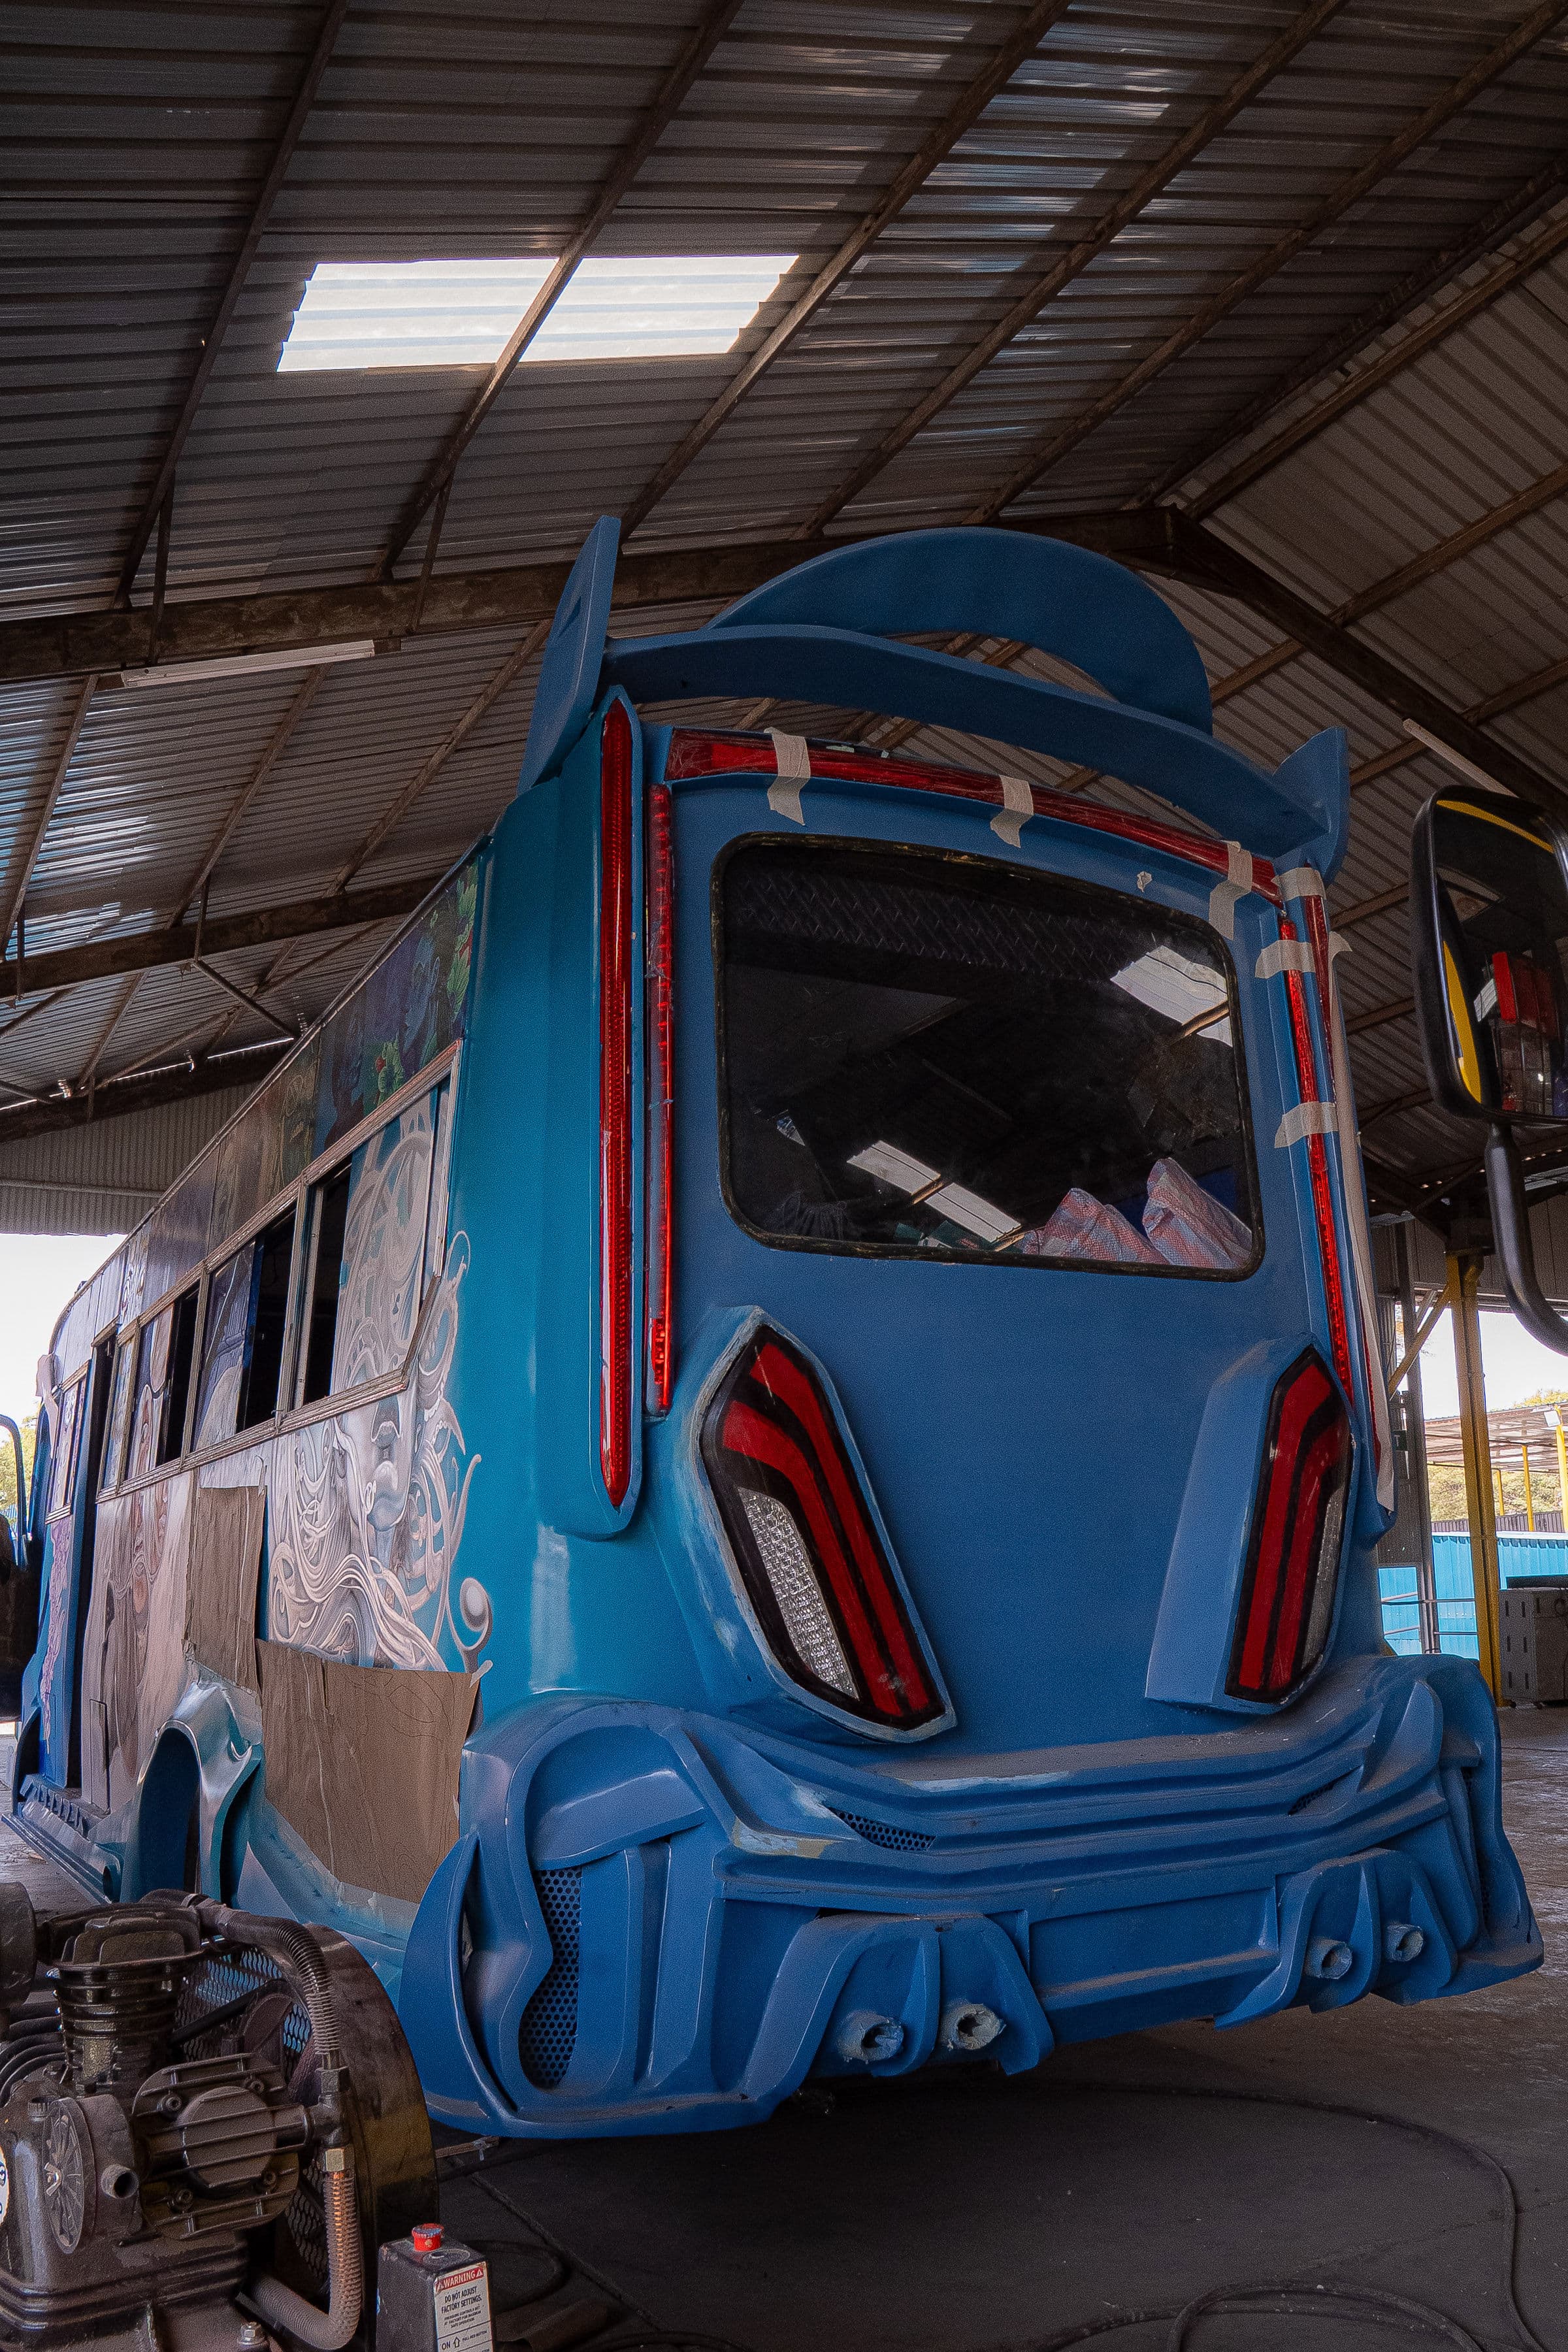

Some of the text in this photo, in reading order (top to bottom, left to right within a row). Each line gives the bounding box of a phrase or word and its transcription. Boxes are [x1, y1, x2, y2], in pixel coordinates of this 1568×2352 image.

[444, 2270, 476, 2287] WARNING
[445, 2287, 477, 2303] DO NOT ADJUST
[442, 2302, 460, 2313] FACTORY
[442, 2341, 451, 2350] ON
